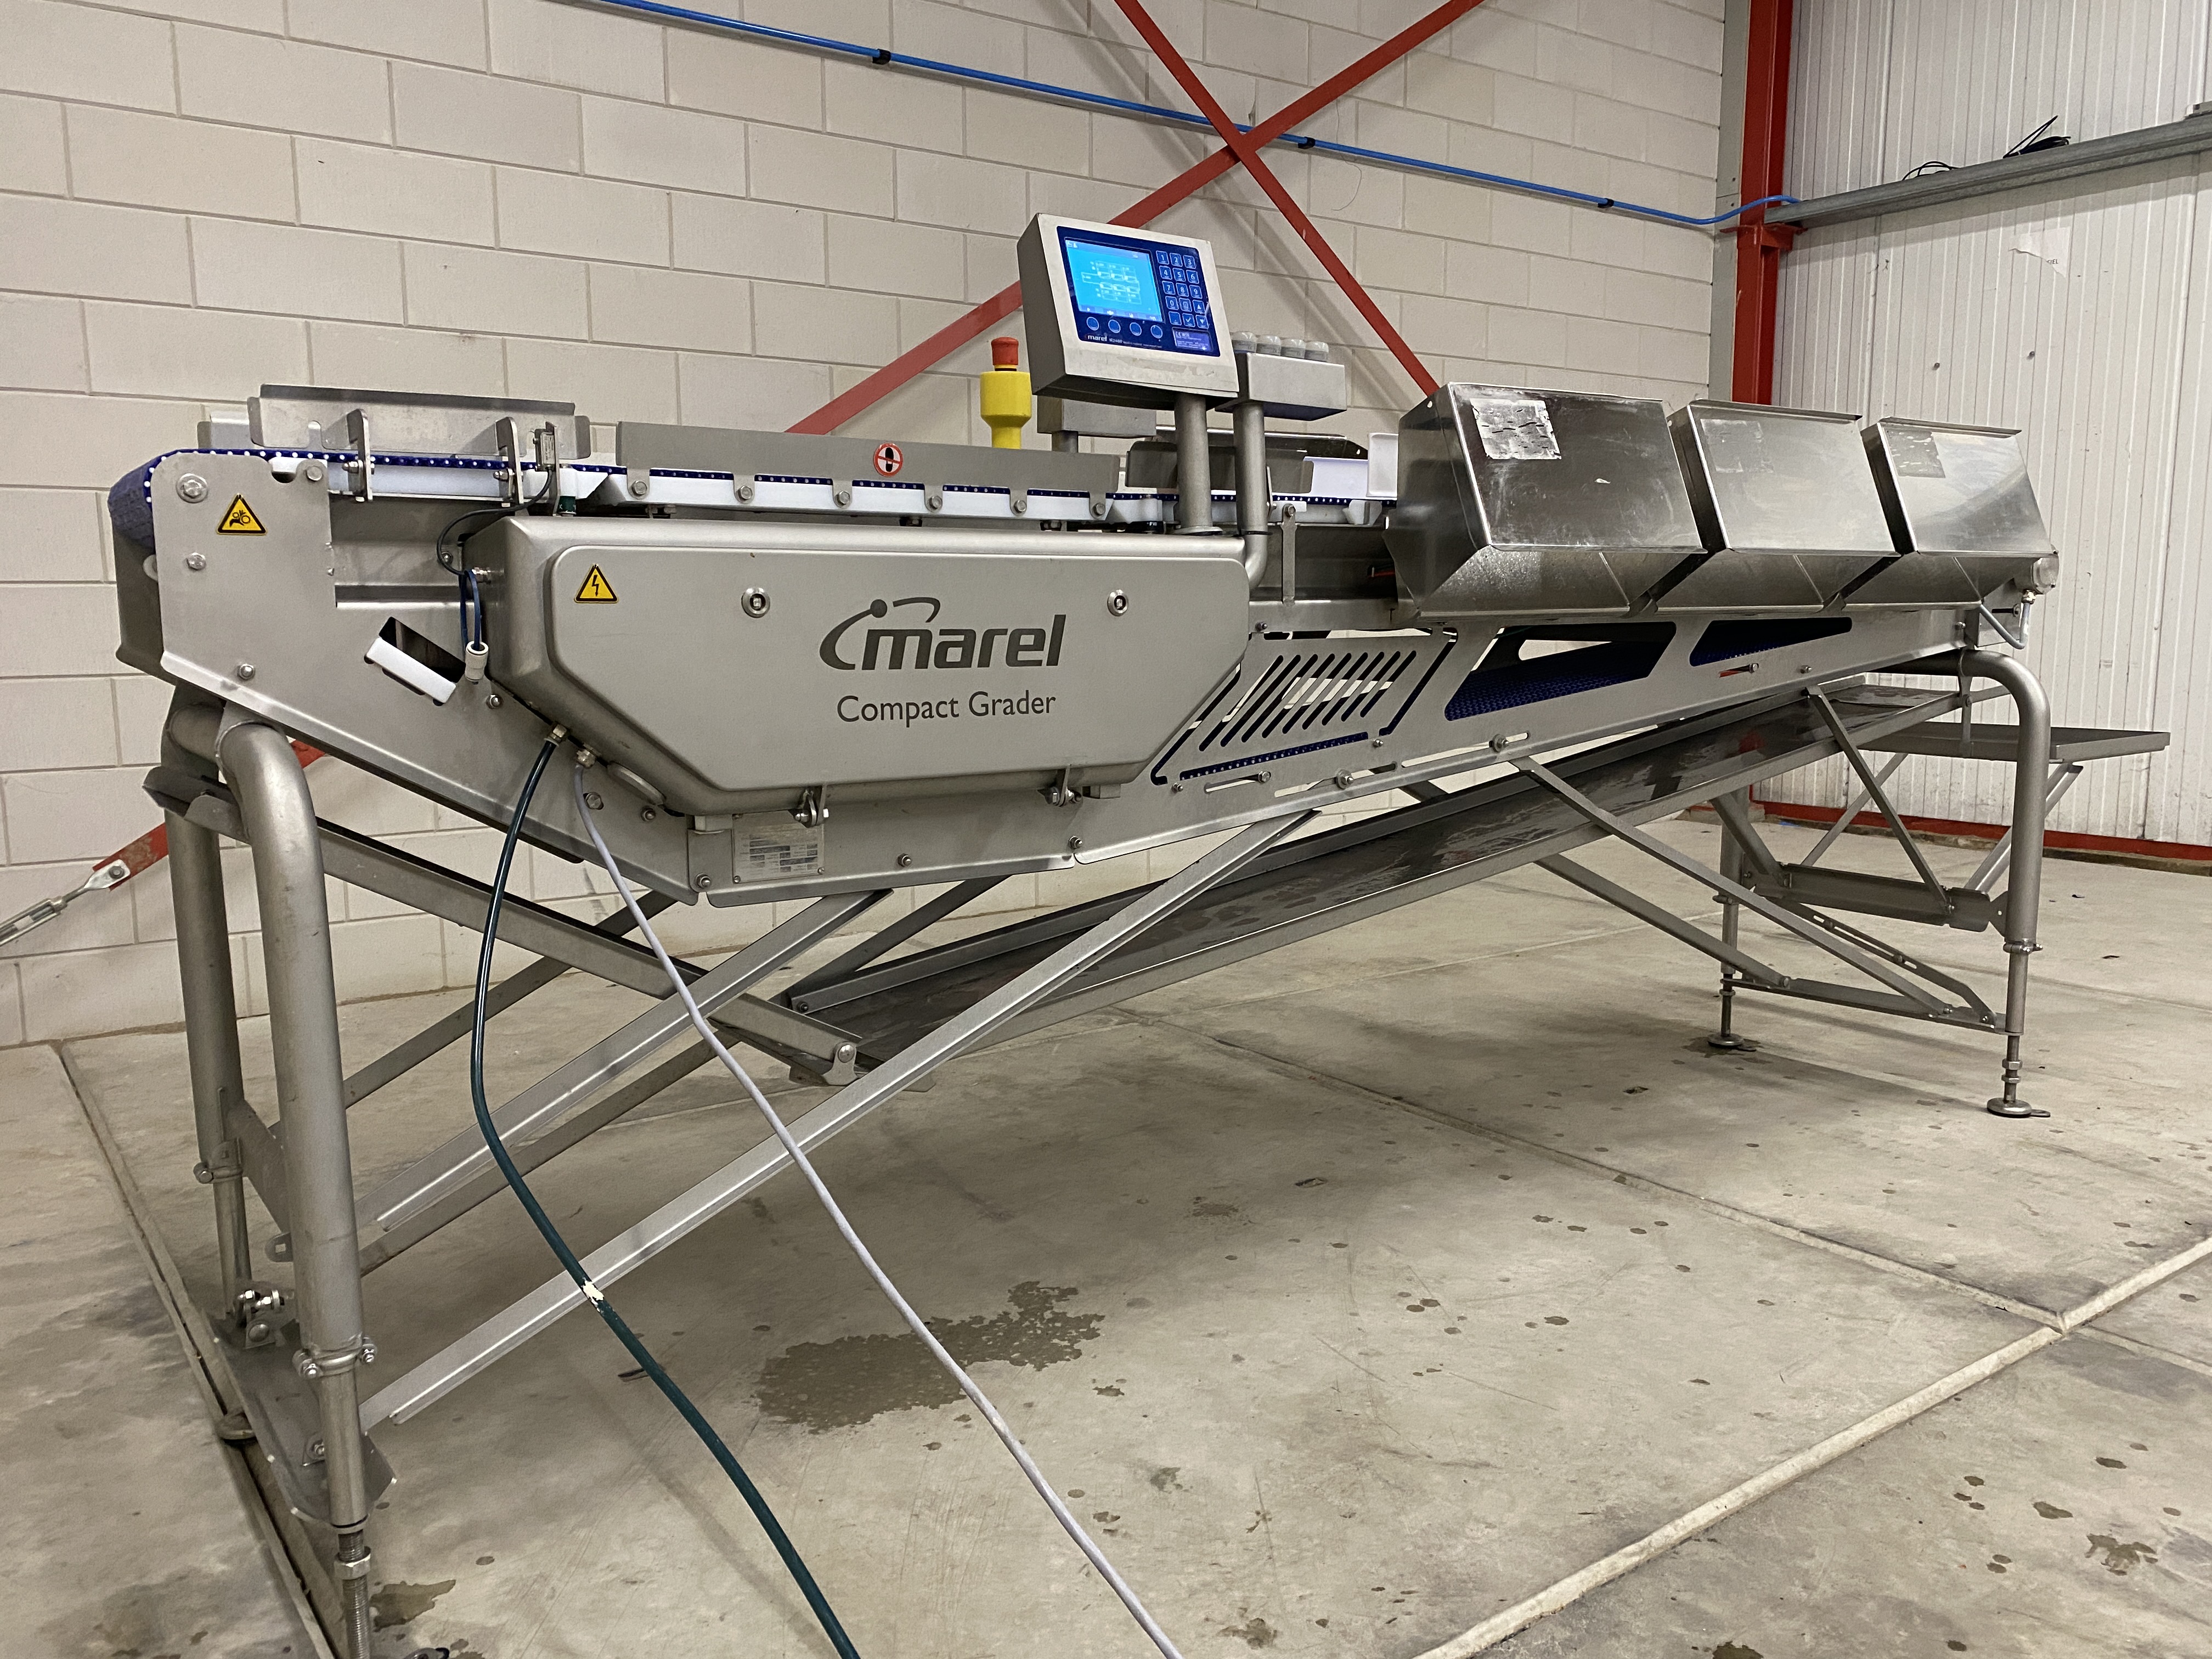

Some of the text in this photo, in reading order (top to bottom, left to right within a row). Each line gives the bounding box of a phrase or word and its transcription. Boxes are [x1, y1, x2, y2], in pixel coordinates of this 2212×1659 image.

[861, 614, 1066, 670] marel
[837, 690, 1056, 728] Compact Grader
